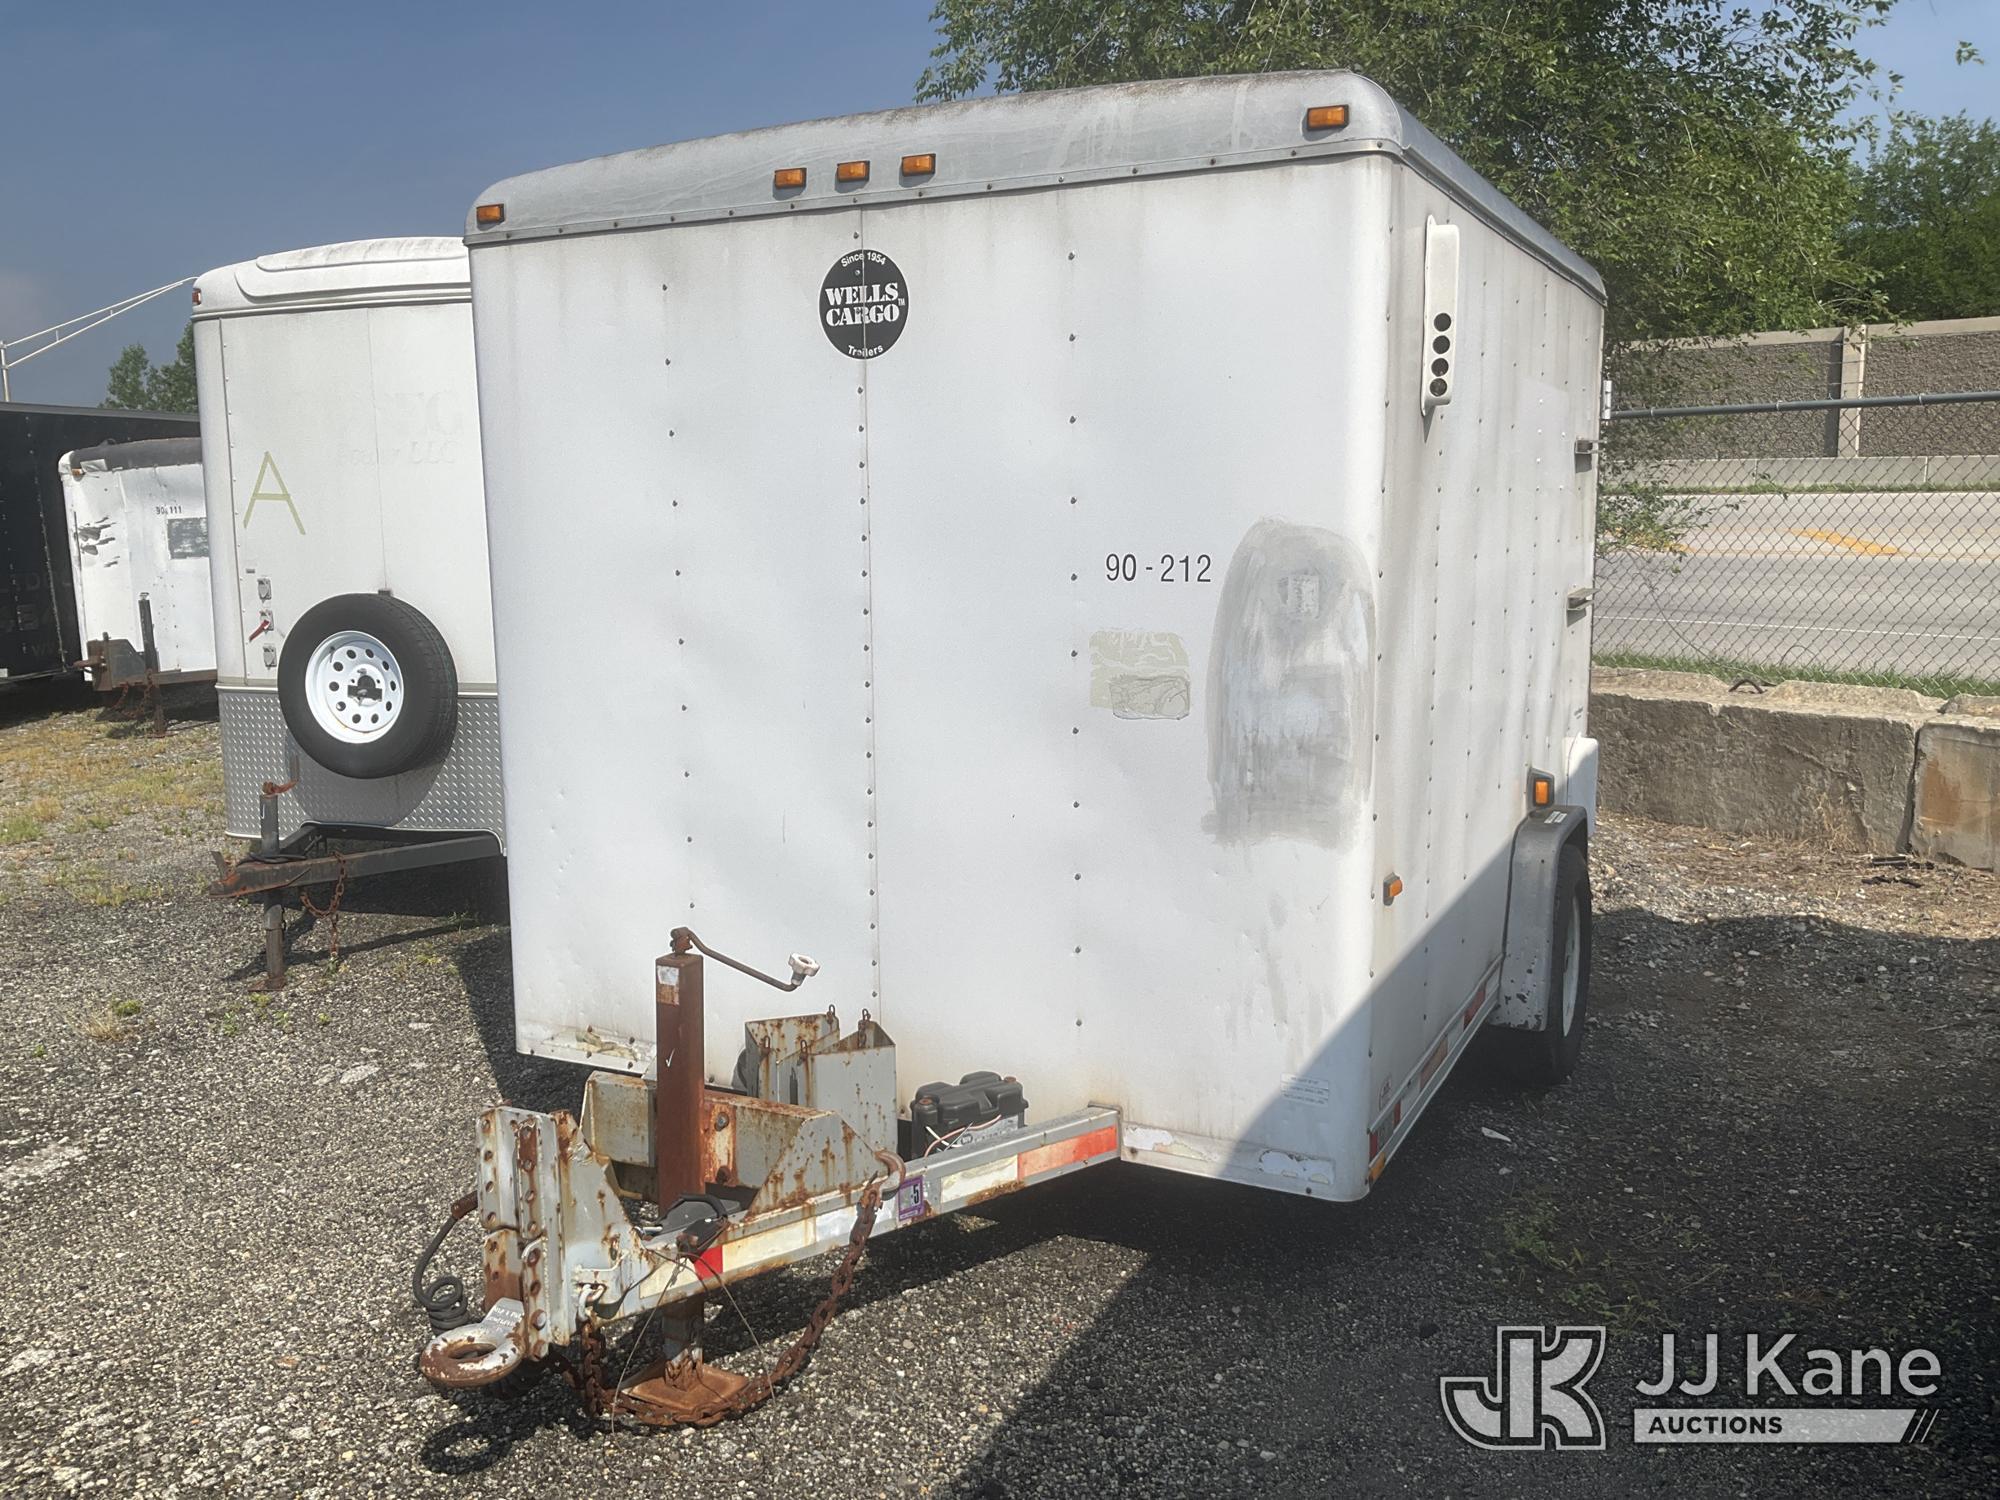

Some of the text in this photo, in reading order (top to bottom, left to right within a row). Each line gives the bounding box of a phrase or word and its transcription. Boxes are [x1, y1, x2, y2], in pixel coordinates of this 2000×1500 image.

[841, 251, 887, 268] Since 1954
[825, 282, 899, 306] WELLS
[826, 303, 900, 327] CARGO
[847, 344, 884, 358] Trailers
[1105, 553, 1212, 583] 90-212
